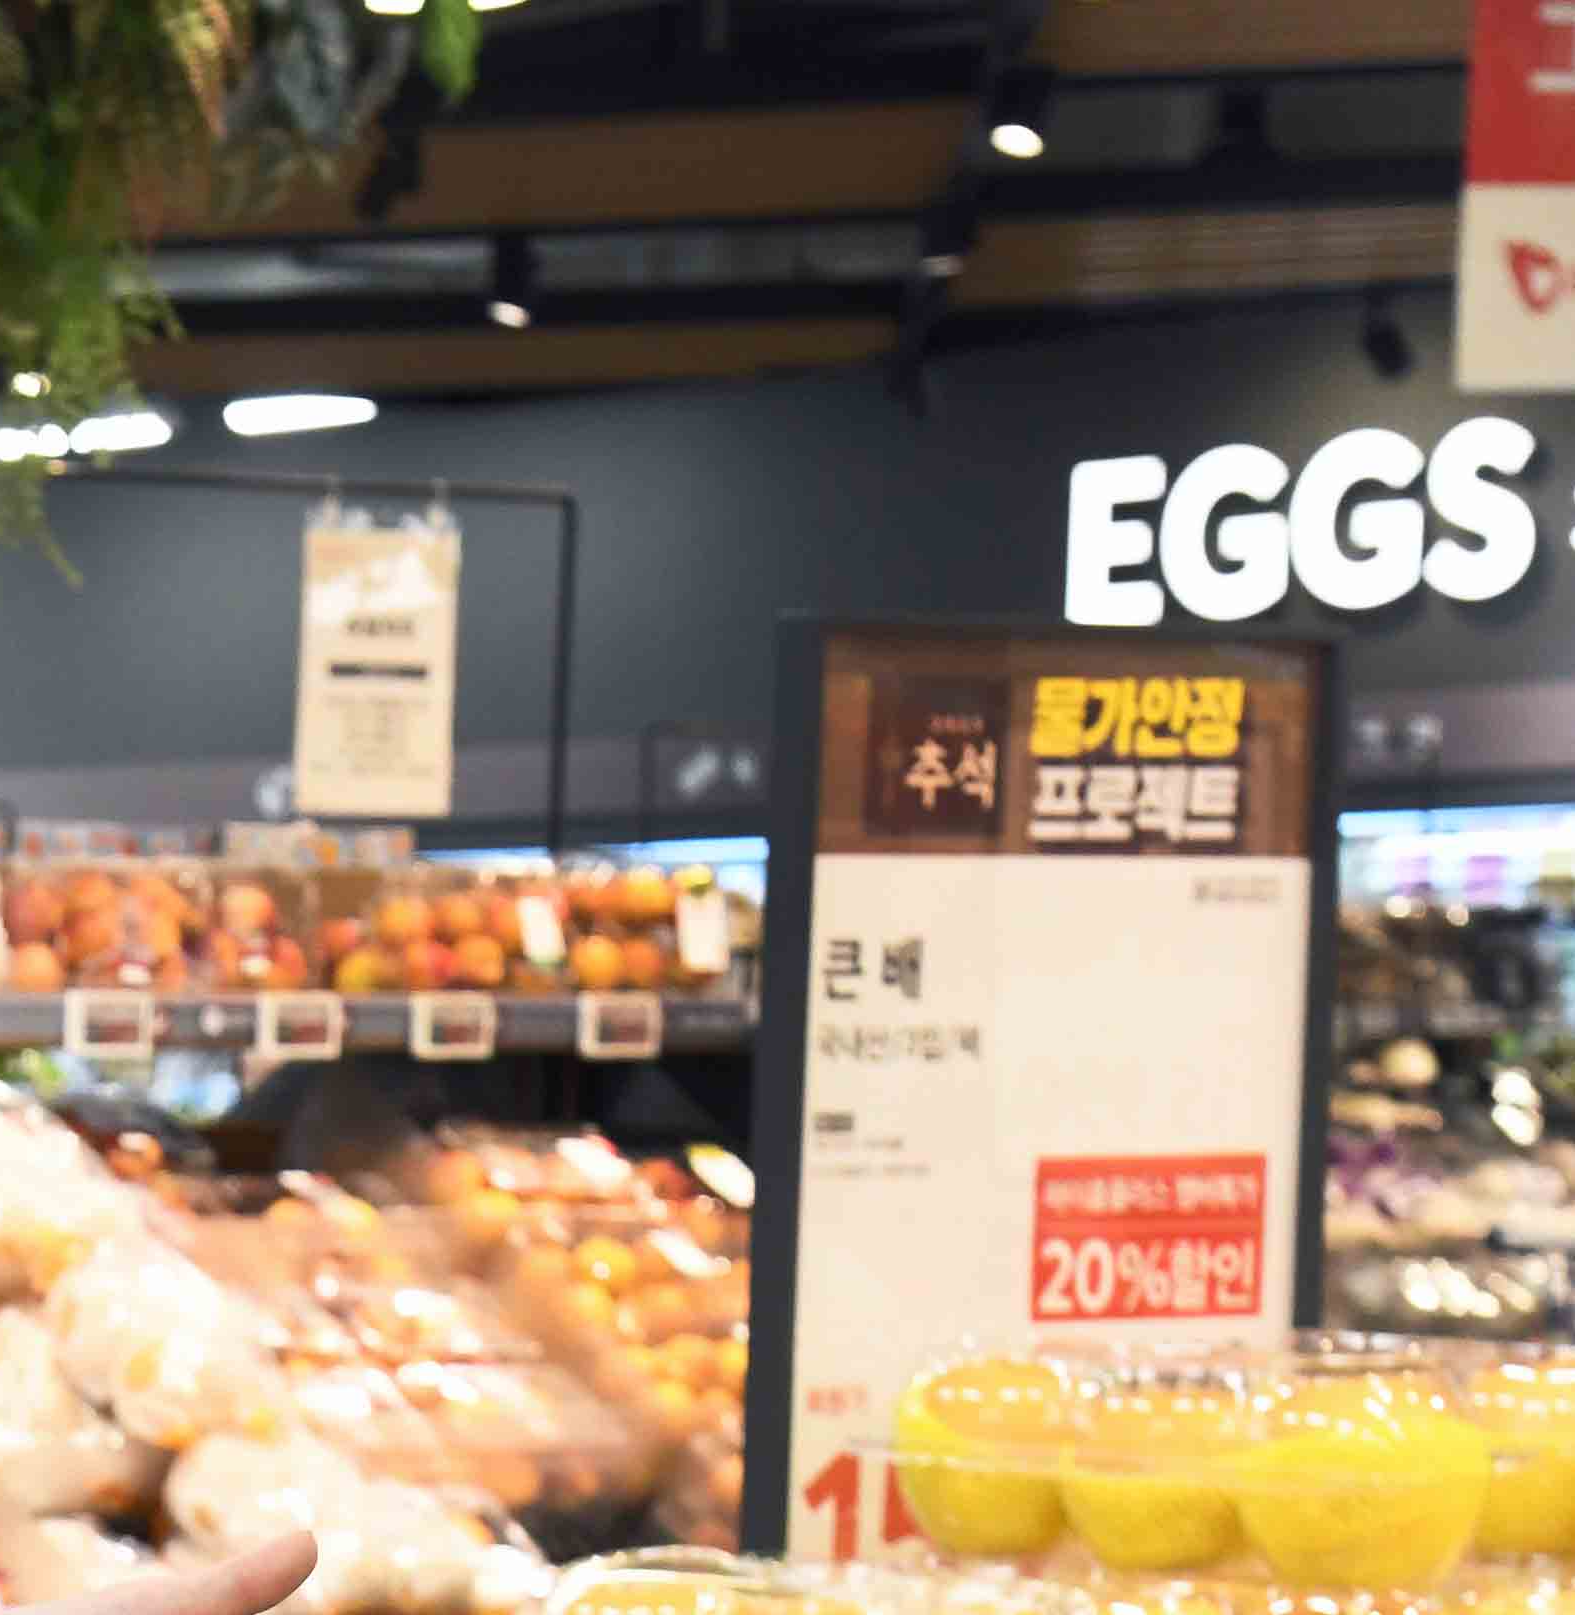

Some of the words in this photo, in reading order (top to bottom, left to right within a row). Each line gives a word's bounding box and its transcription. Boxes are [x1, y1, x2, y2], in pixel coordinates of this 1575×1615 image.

[1064, 416, 1537, 627] EGGS
[1029, 676, 1244, 757] 물가안정
[1028, 764, 1241, 843] 프로젝트
[1038, 1236, 1255, 1314] 20%할인
